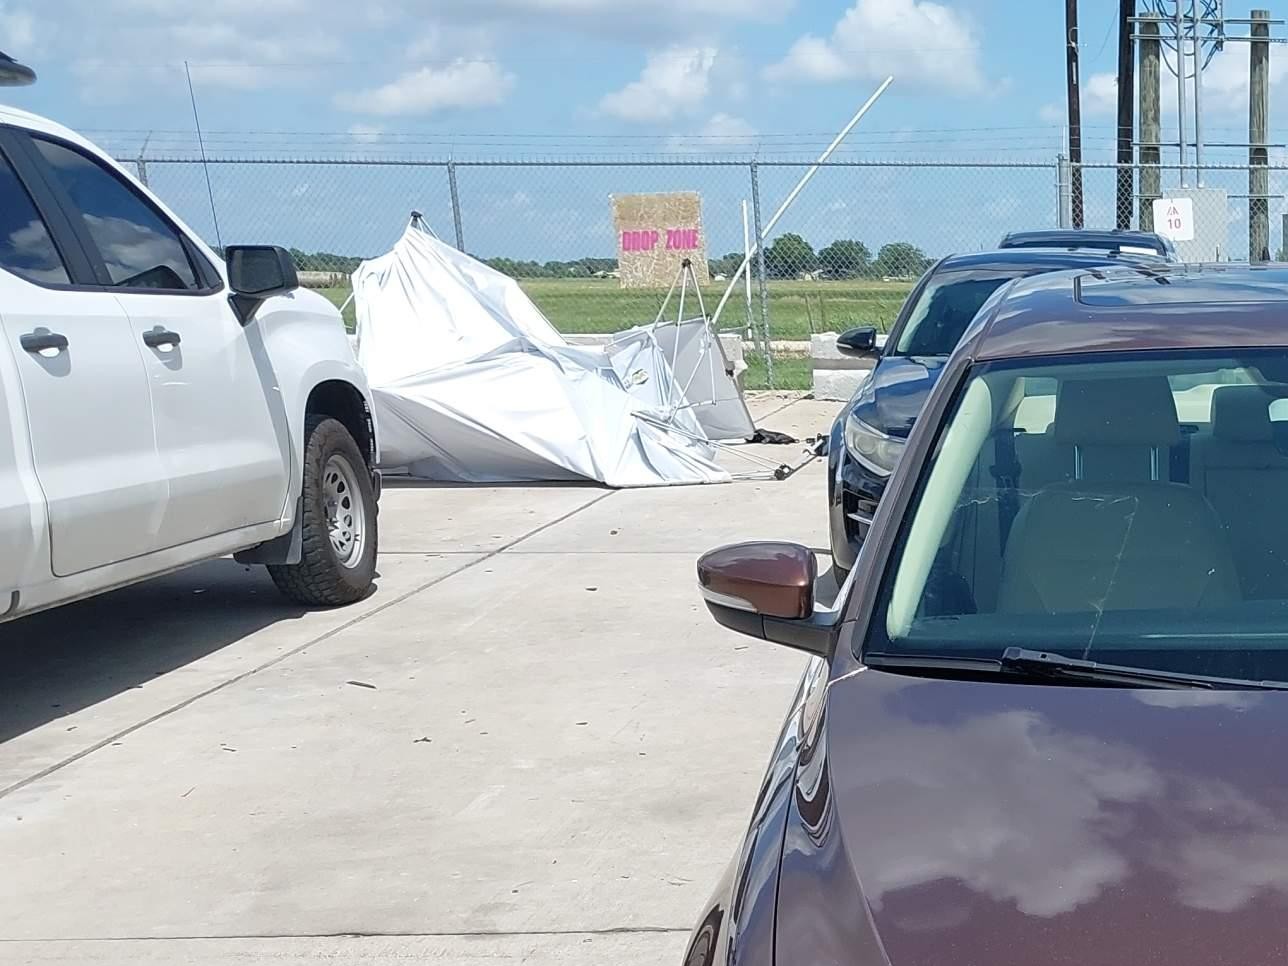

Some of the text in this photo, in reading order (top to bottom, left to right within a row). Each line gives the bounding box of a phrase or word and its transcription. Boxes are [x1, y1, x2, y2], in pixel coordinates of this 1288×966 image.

[1168, 218, 1181, 229] 10
[622, 229, 699, 251] DROP ZONE
